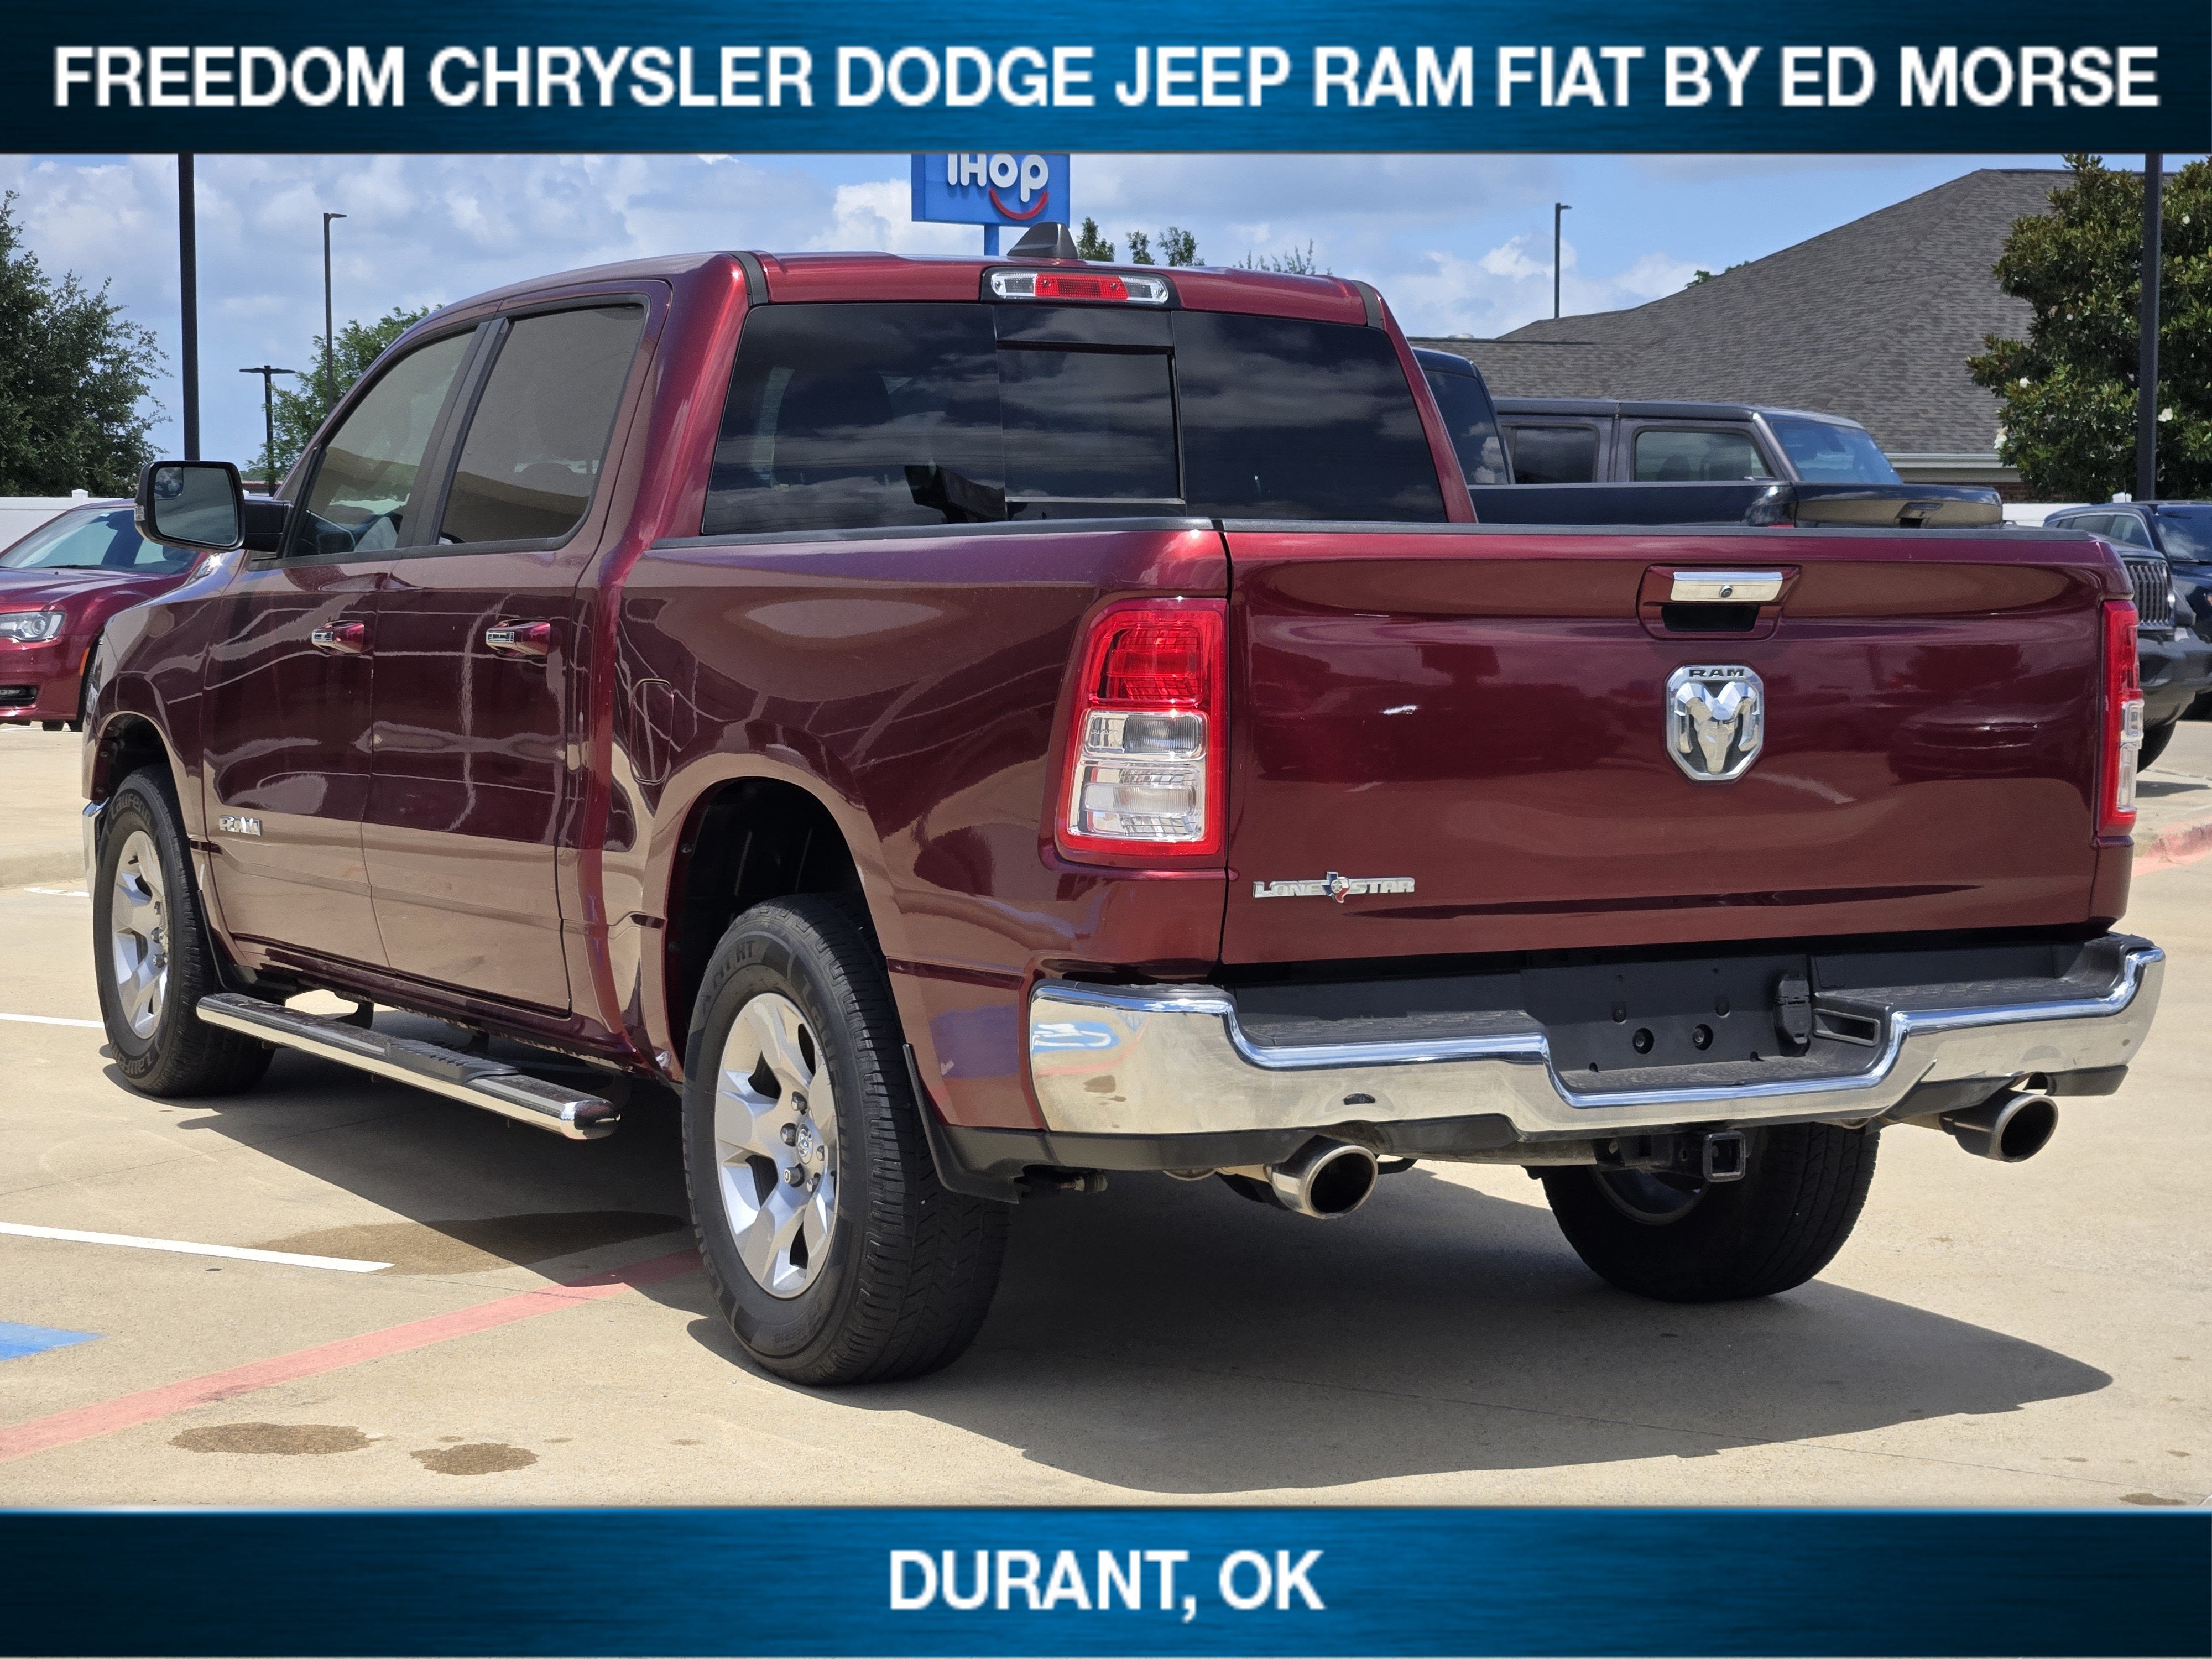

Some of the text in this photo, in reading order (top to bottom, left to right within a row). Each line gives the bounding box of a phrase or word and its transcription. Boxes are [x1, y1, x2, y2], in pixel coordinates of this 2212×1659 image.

[1689, 669, 1744, 678] RAM
[218, 814, 263, 836] RAM
[1252, 877, 1415, 898] LONE STAR
